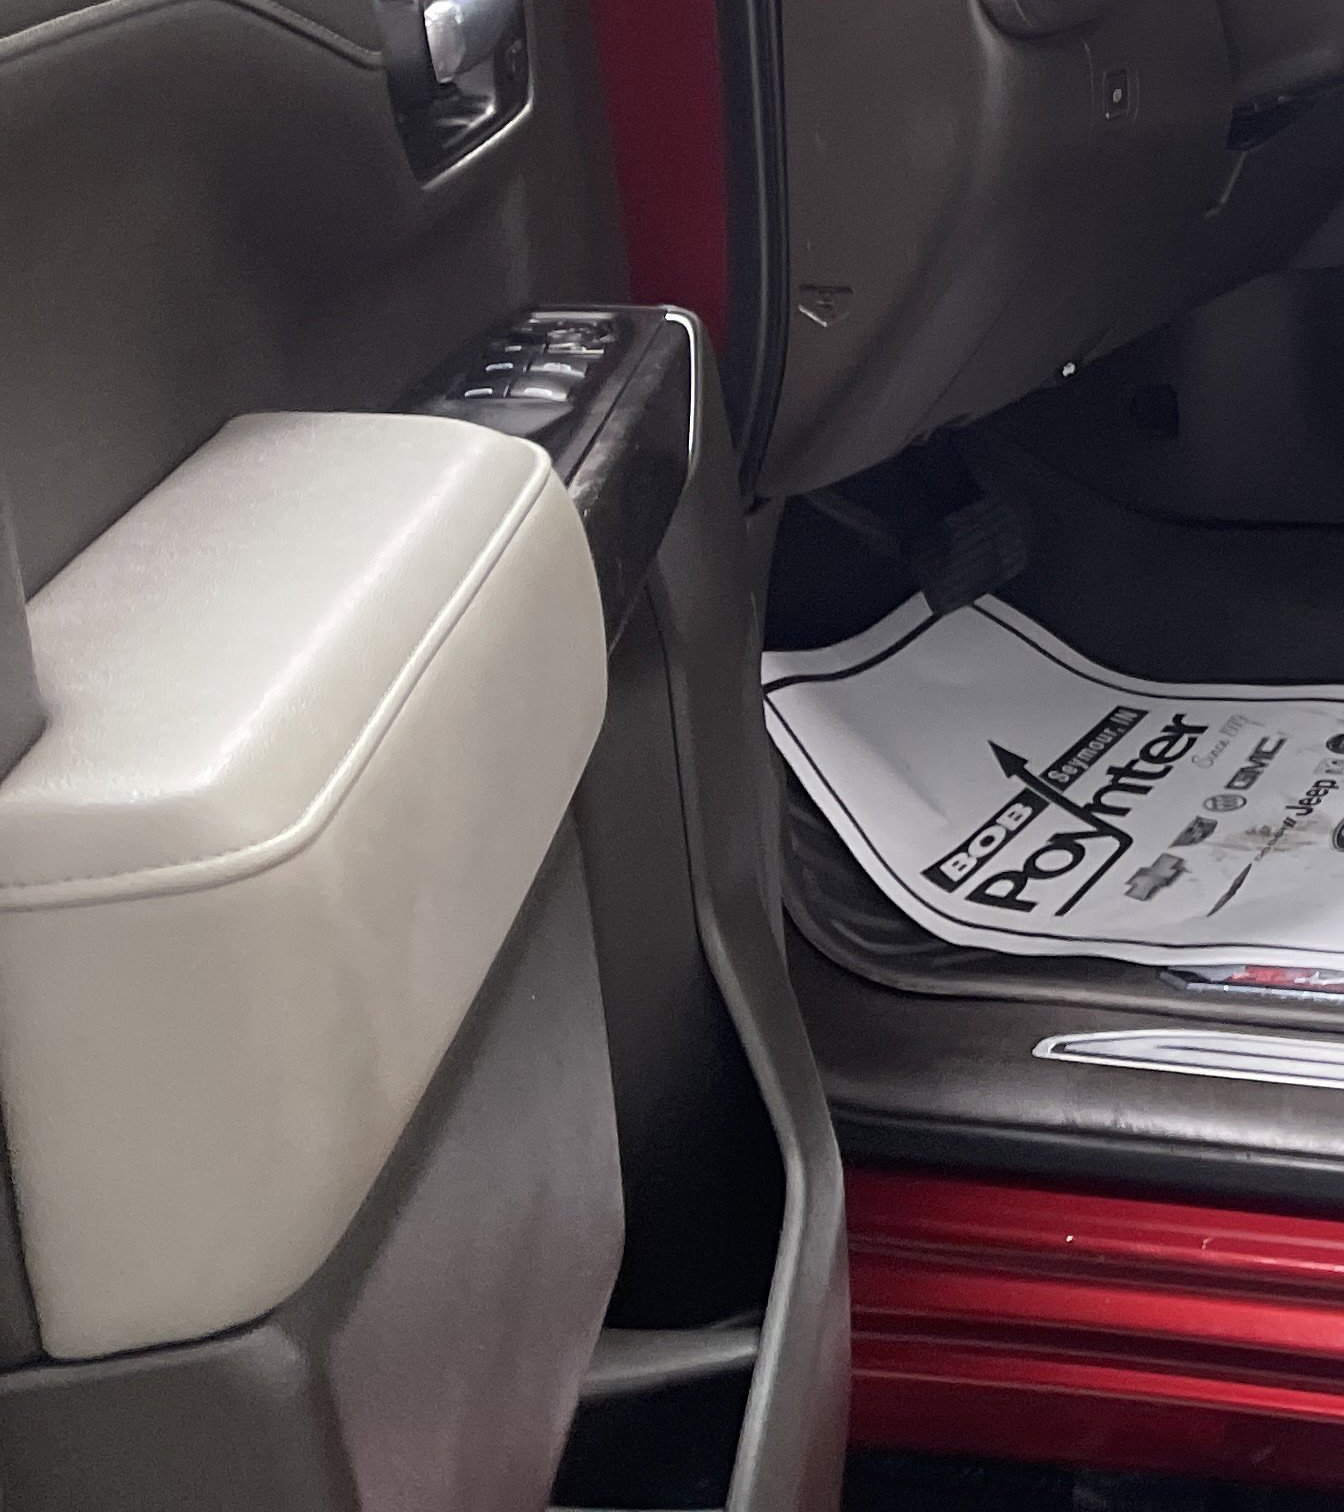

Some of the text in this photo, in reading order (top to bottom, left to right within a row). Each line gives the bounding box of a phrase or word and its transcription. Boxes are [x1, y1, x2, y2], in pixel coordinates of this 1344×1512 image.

[1110, 709, 1138, 726] IN
[1224, 735, 1288, 790] GMC
[965, 713, 1209, 917] Poynter
[1285, 778, 1340, 817] Jeep
[939, 802, 1033, 883] BOB
